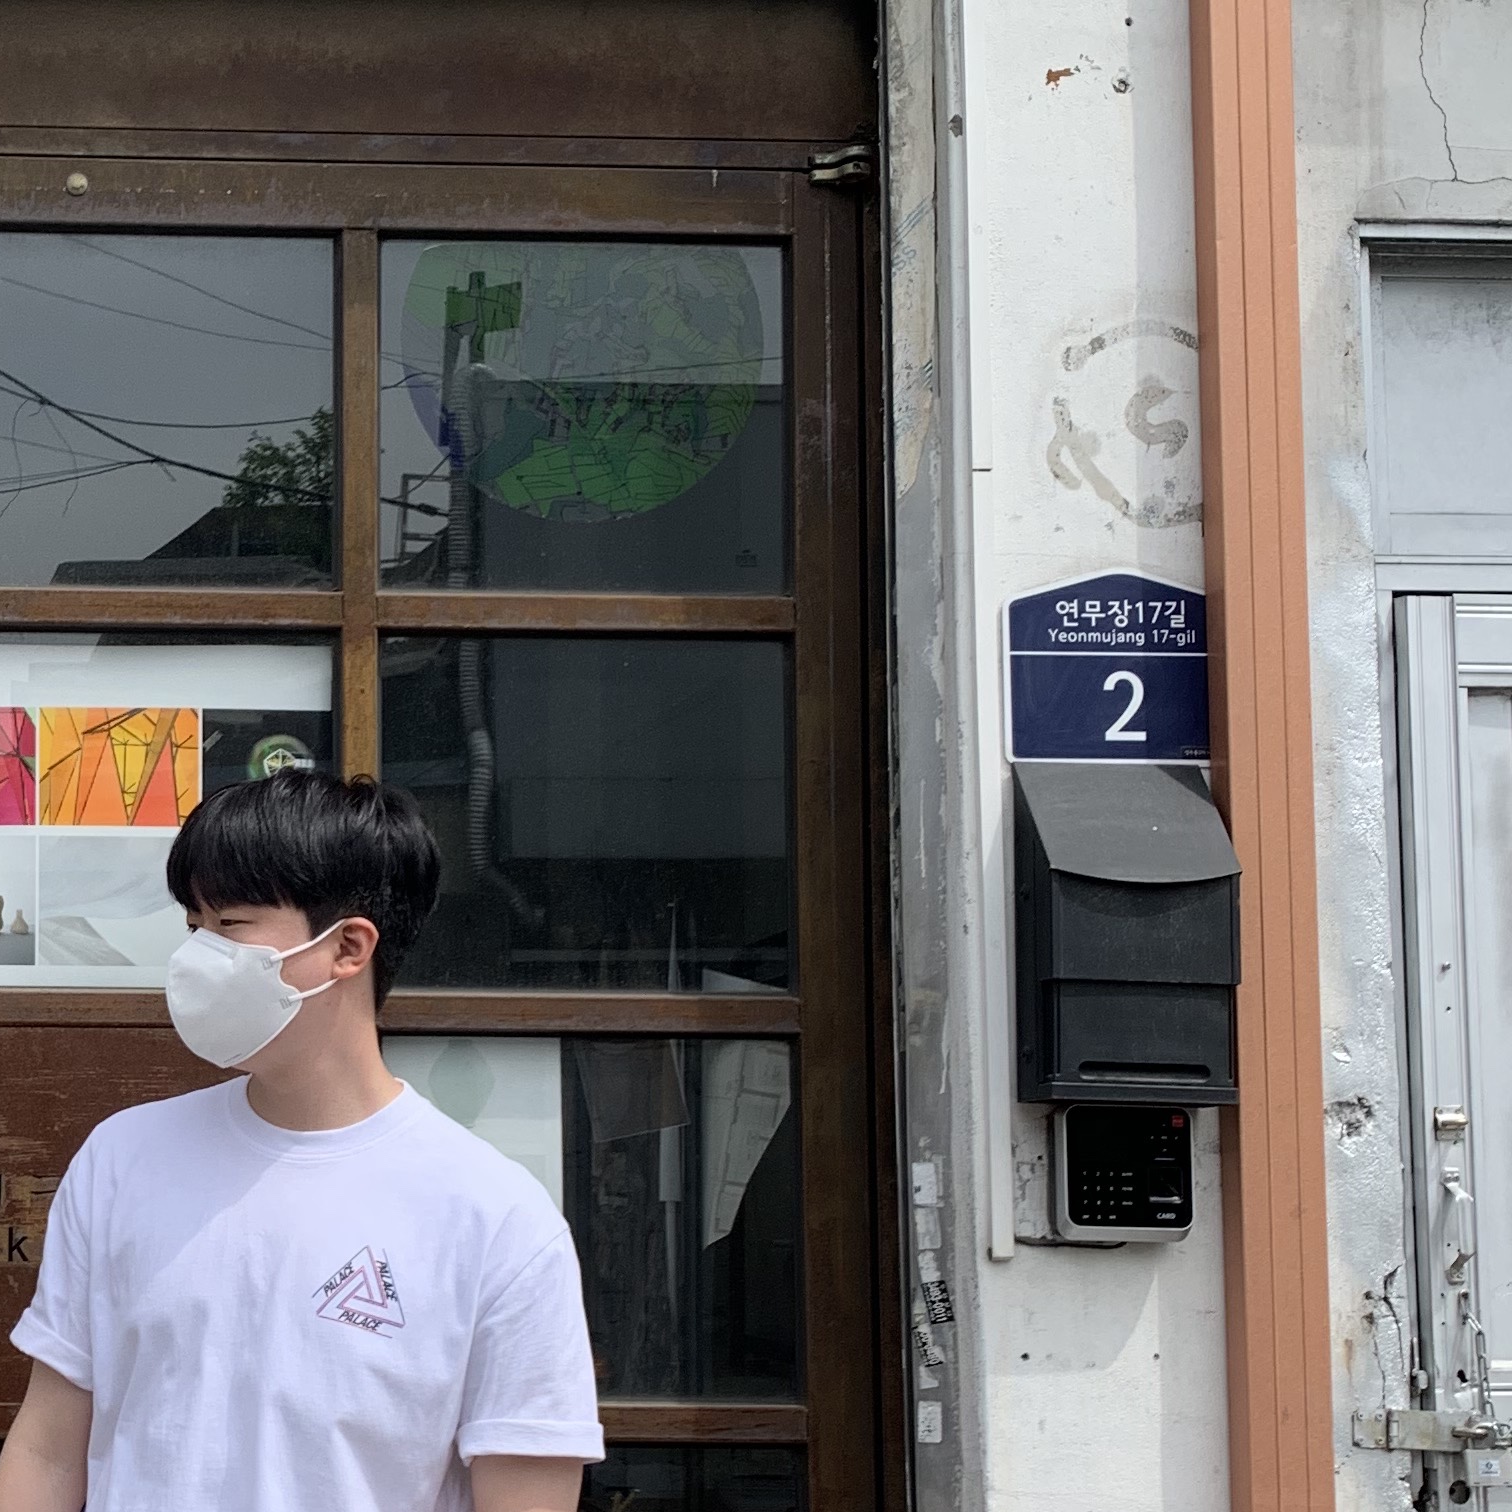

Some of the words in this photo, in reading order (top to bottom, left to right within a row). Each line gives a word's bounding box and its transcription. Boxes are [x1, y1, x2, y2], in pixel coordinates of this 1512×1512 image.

[1055, 599, 1186, 628] 연무장17길
[1048, 628, 1145, 646] Yeonmujang
[1152, 629, 1196, 646] 17-gil
[1103, 670, 1147, 741] 2
[322, 1261, 355, 1298] PALACE
[338, 1310, 383, 1332] PALACE
